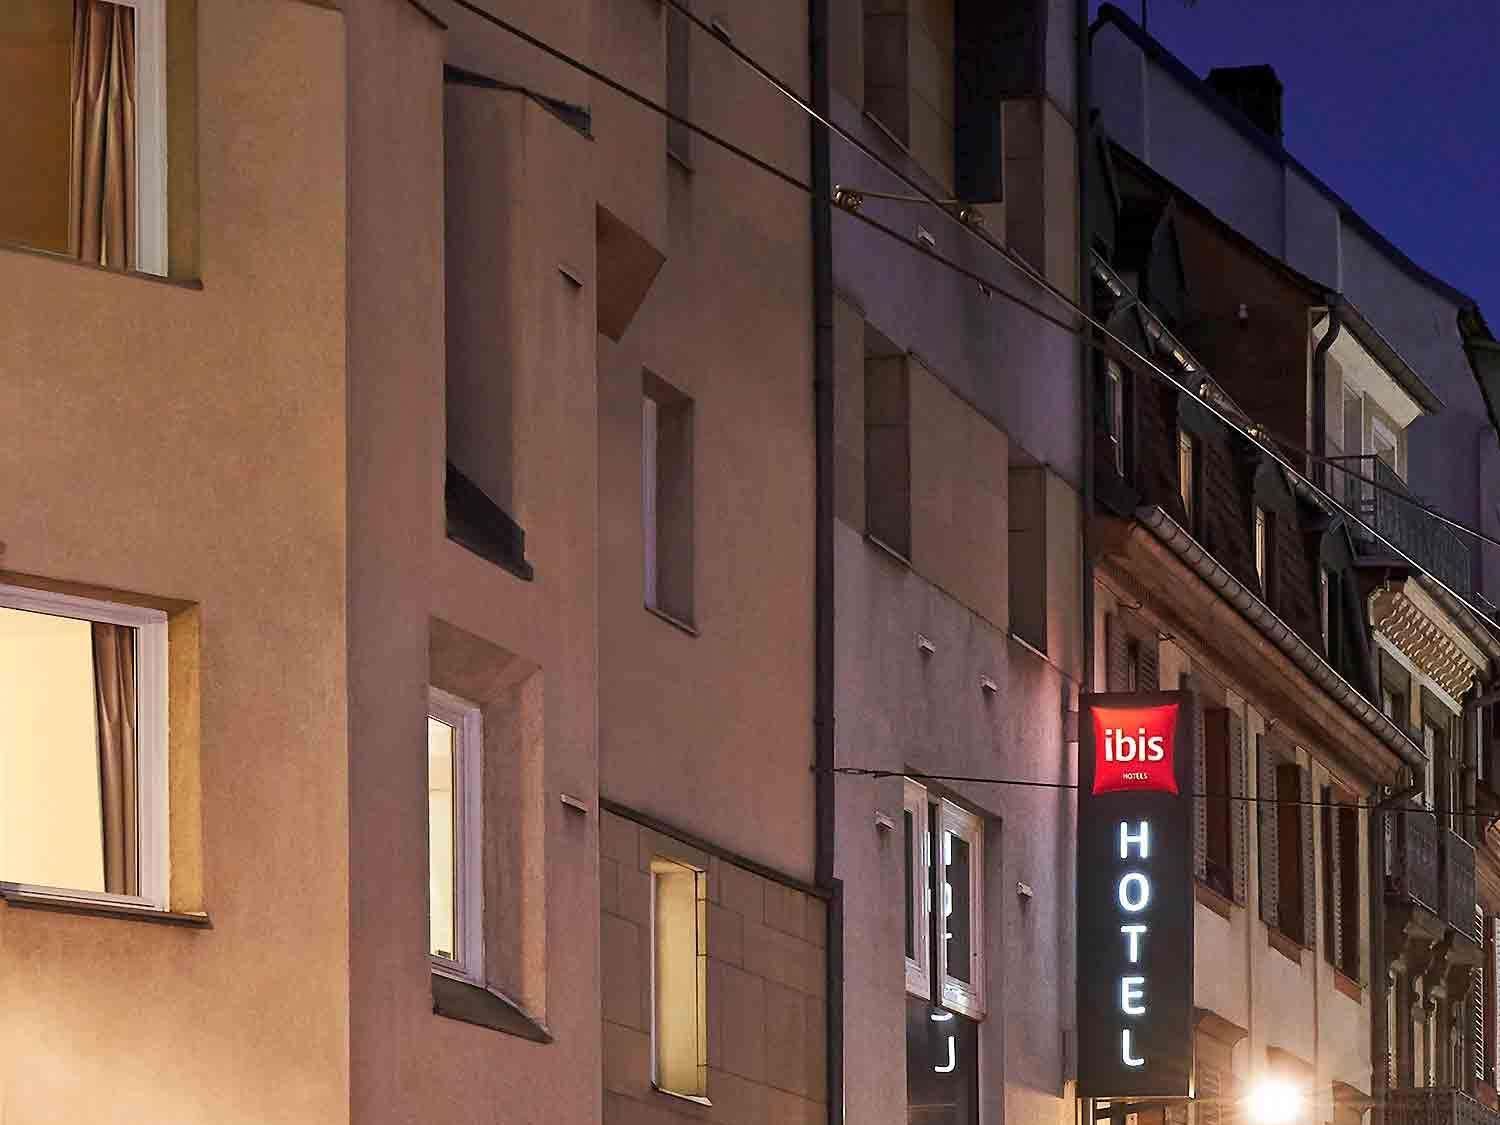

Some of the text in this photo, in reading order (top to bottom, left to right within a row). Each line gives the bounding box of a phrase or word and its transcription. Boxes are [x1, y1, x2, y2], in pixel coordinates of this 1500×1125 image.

[1104, 727, 1164, 762] ibis
[1122, 772, 1148, 780] HOTELS
[1118, 820, 1150, 1066] HOTEL
